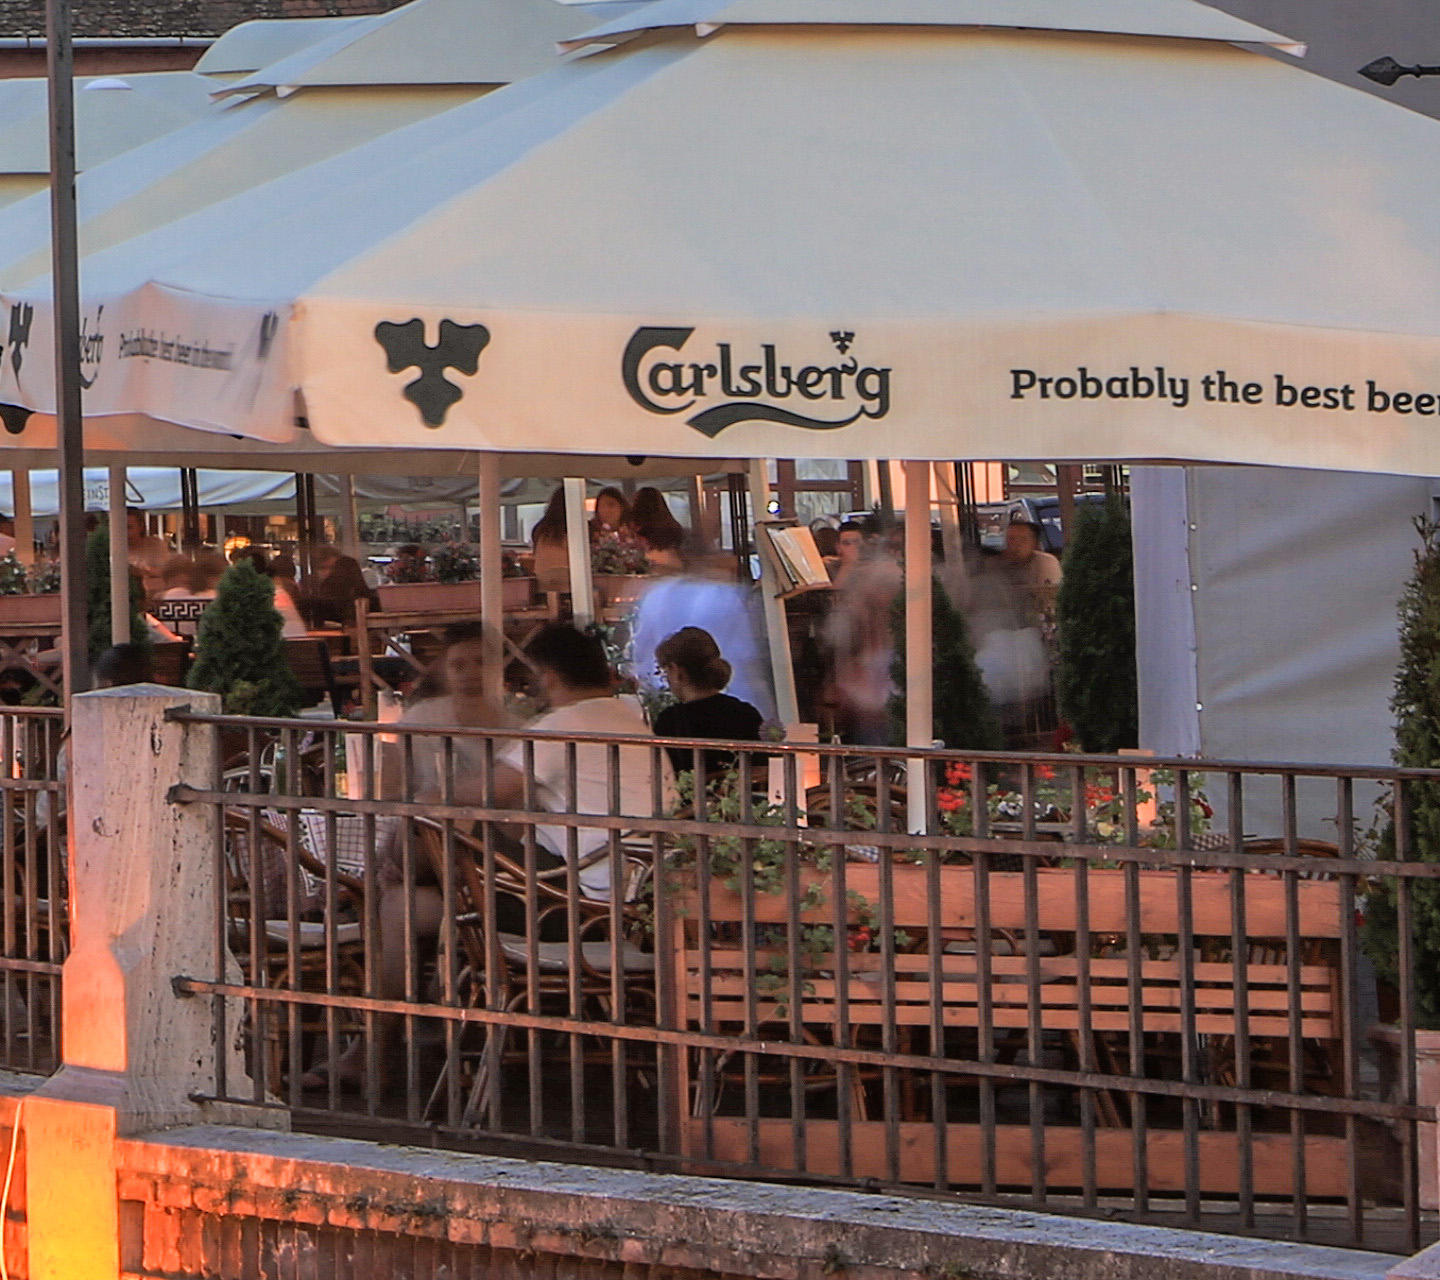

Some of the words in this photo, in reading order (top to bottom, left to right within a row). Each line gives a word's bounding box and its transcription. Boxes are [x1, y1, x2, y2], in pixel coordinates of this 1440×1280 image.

[622, 326, 892, 439] Carlsberg
[1010, 367, 1189, 407] Probably
[1201, 371, 1263, 405] the
[1275, 374, 1355, 411] best
[1366, 380, 1440, 417] bee
